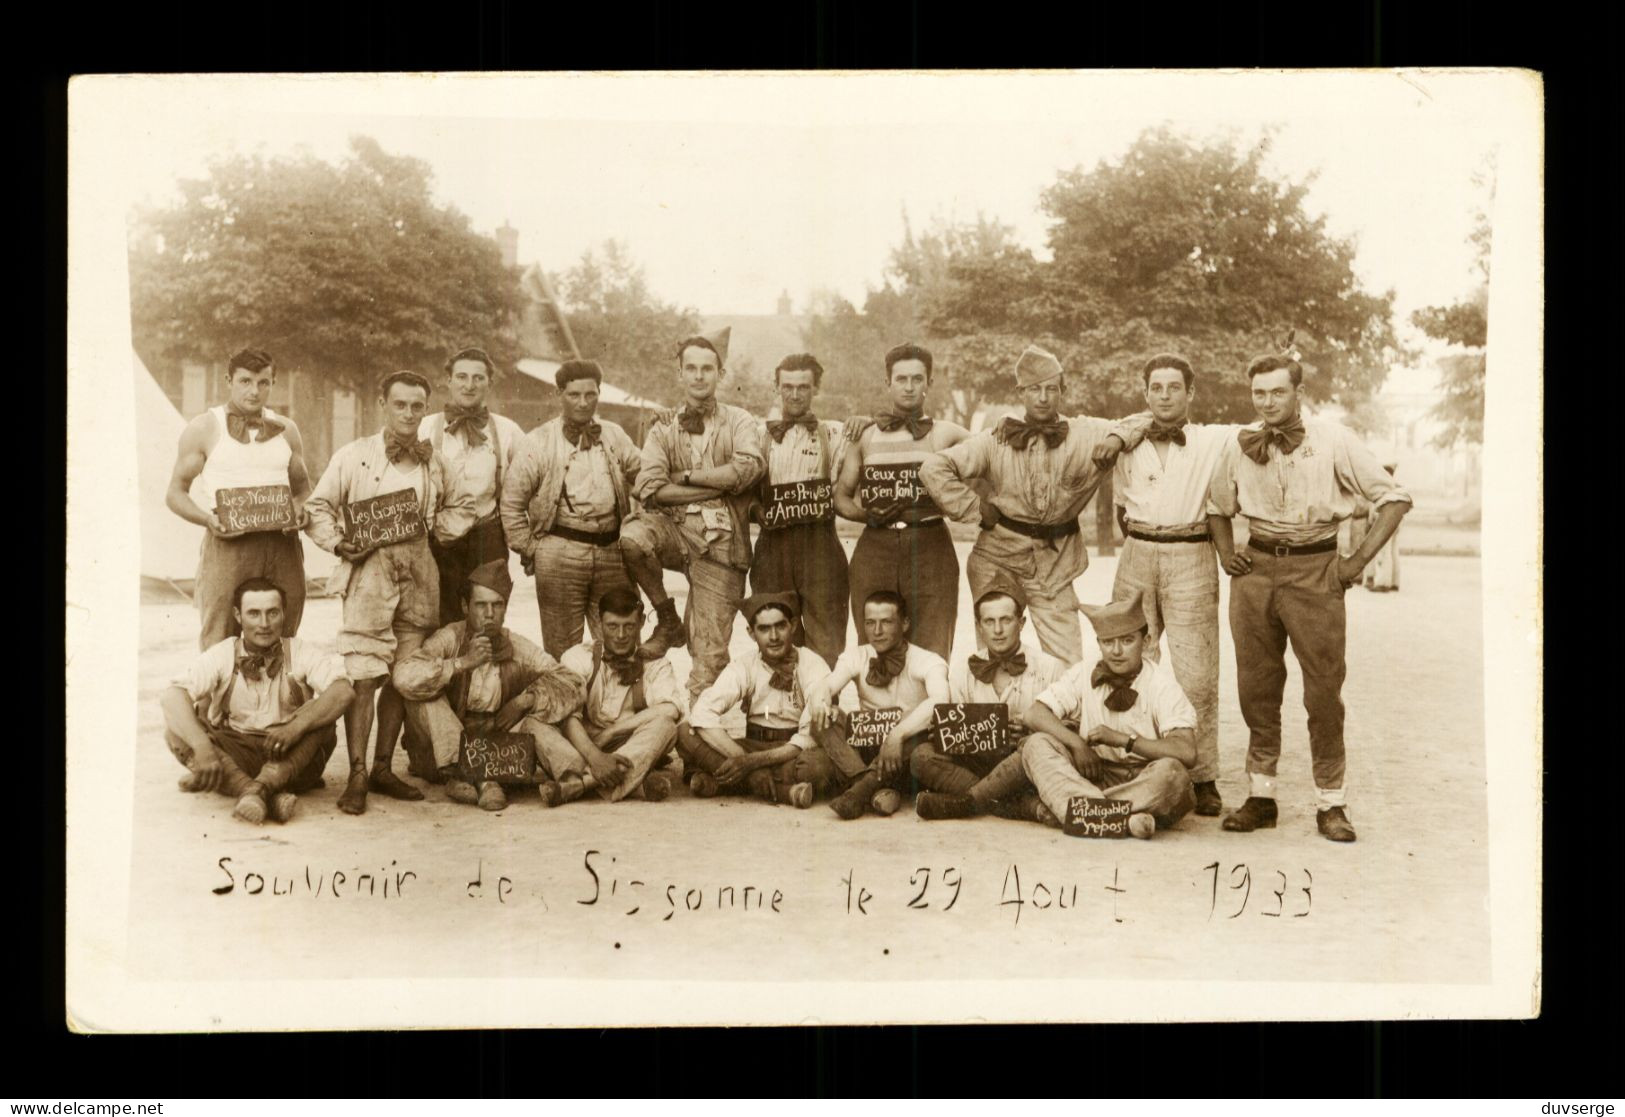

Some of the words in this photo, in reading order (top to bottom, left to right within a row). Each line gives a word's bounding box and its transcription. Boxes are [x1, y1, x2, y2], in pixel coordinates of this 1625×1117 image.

[865, 466, 896, 481] Ceux
[773, 487, 797, 501] Les
[347, 503, 371, 526] Les
[851, 711, 871, 724] Les
[874, 709, 902, 721] bons
[933, 703, 966, 725] Les
[464, 734, 488, 751] Les
[846, 733, 875, 747] dans
[484, 761, 526, 778] Réunis
[1071, 797, 1090, 808] Les
[212, 857, 416, 899] Souvenir
[467, 857, 513, 903] de
[907, 867, 962, 912] 29
[1203, 861, 1313, 923] 1933
